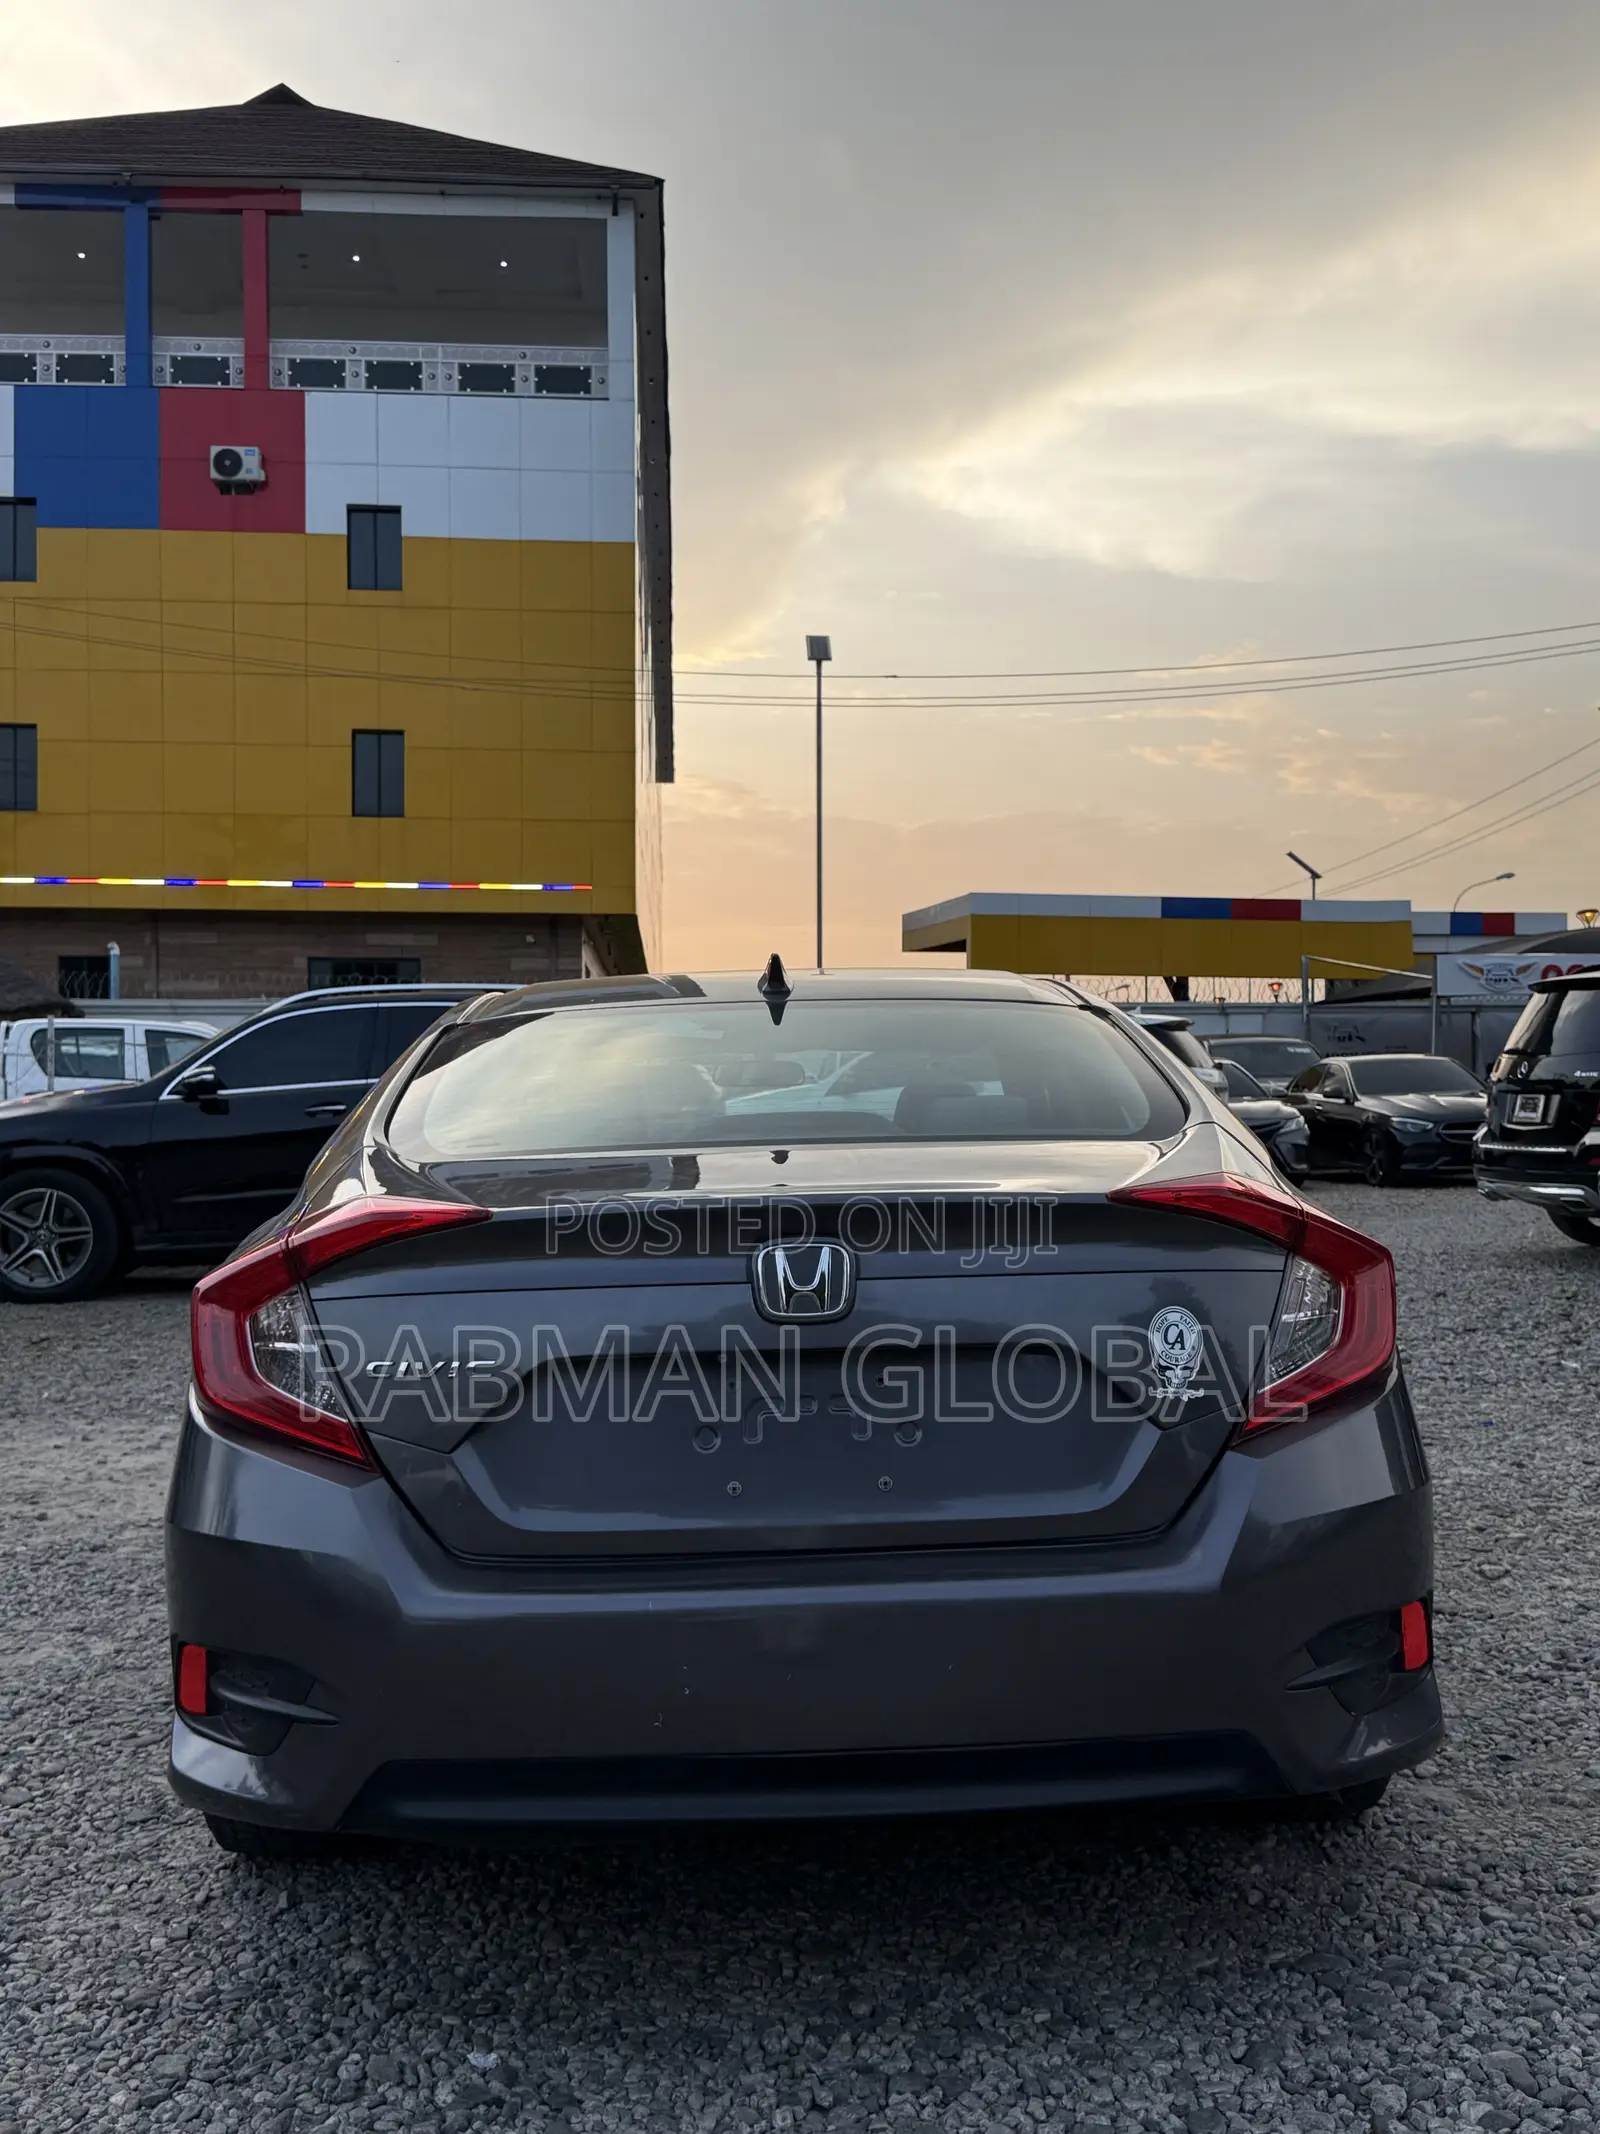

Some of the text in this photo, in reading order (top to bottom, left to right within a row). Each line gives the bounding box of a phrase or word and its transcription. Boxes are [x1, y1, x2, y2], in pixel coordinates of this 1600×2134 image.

[1155, 1315, 1197, 1335] HOPE FAITH
[1163, 1323, 1187, 1350] CA
[1160, 1350, 1193, 1363] COURAGE
[365, 1360, 496, 1379] CIVIC
